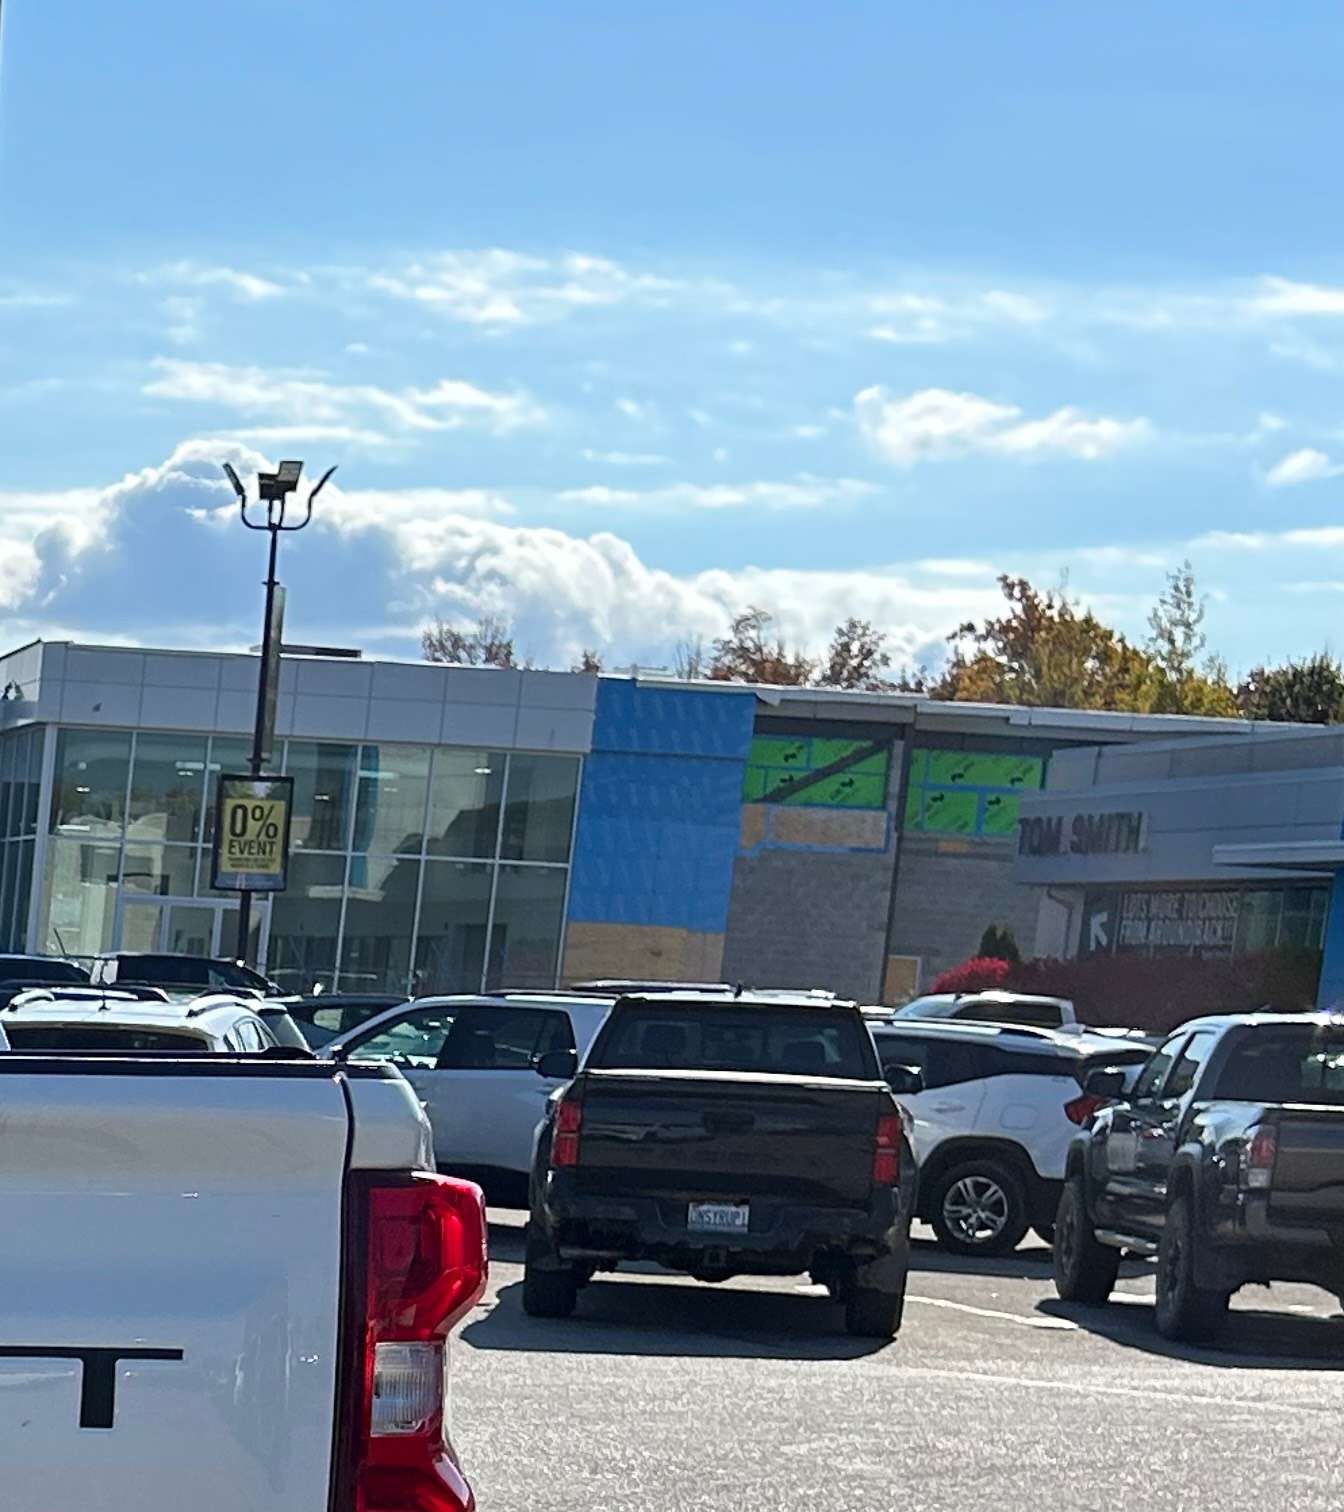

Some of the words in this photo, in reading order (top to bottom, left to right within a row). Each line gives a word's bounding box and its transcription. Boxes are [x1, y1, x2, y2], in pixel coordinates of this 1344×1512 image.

[230, 803, 278, 840] 0%
[1018, 814, 1063, 857] TOM
[1070, 810, 1144, 854] SMITH
[228, 840, 275, 856] EVENT
